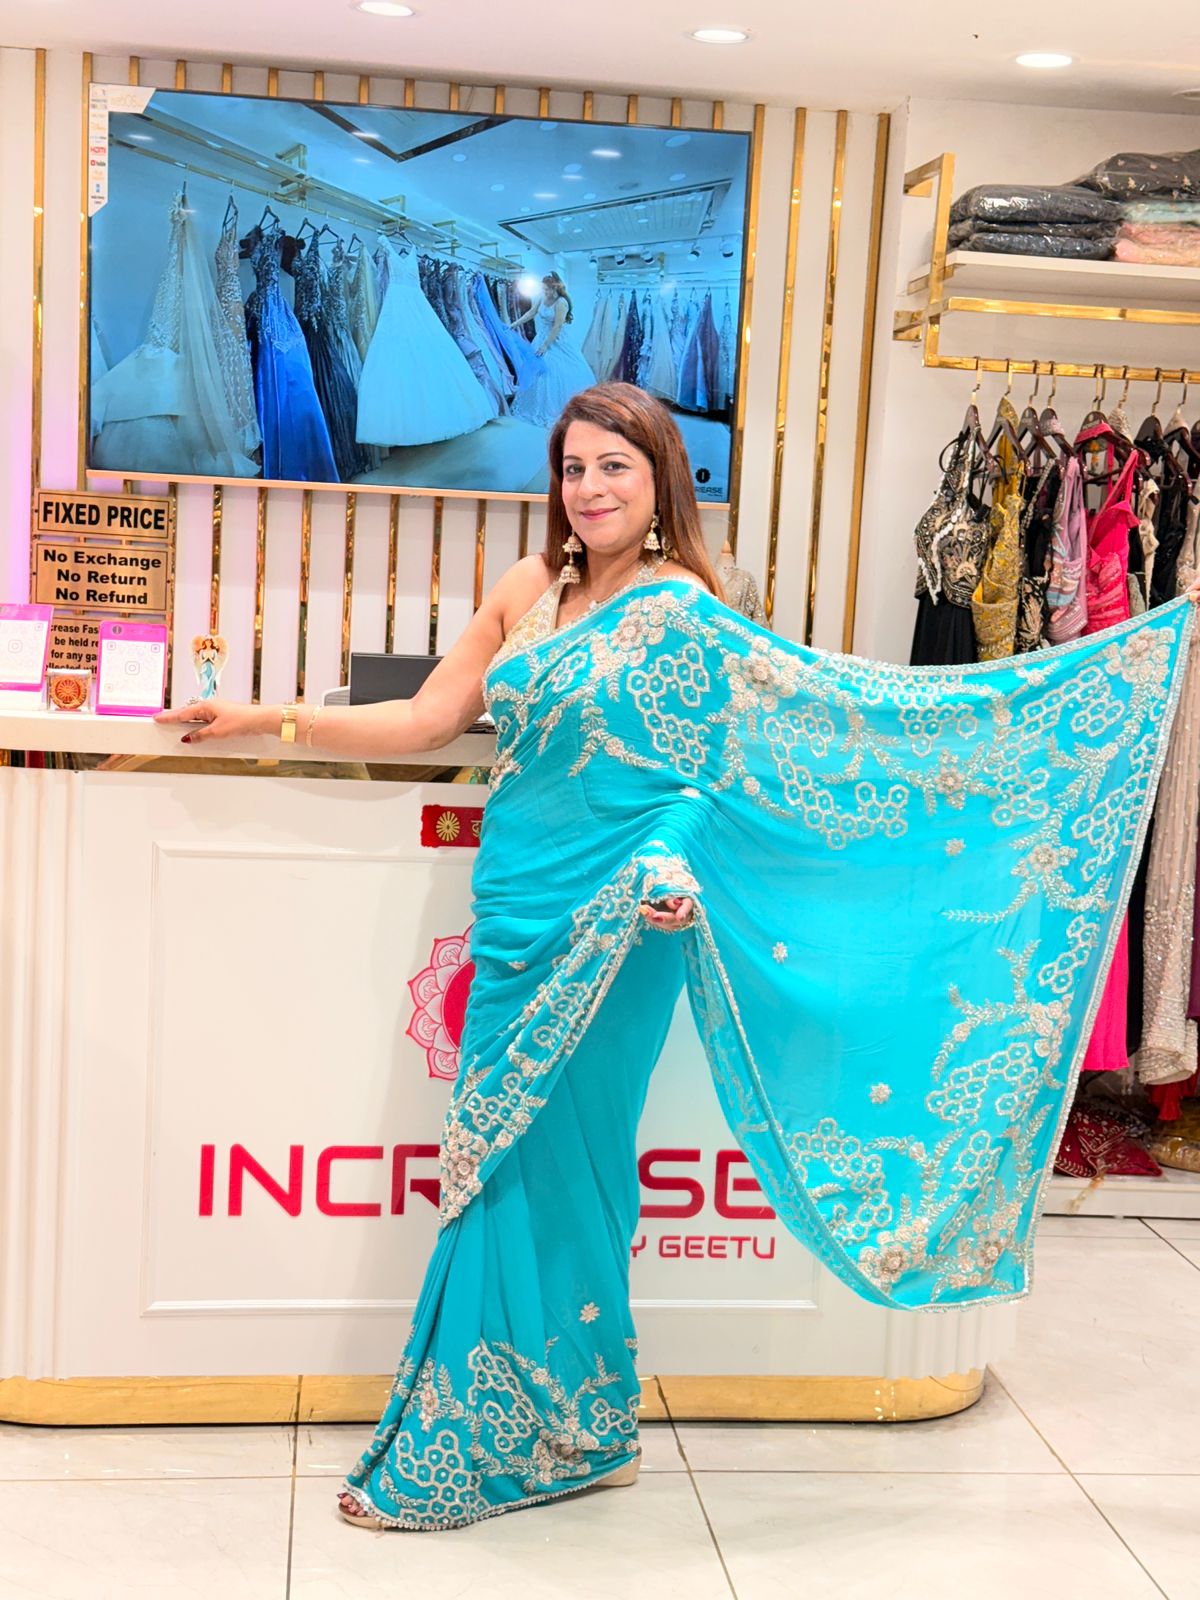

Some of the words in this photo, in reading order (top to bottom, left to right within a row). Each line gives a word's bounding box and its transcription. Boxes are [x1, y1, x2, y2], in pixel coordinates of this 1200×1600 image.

[695, 486, 724, 494] REASE
[43, 501, 100, 525] FIXED
[107, 505, 165, 530] PRICE
[43, 549, 68, 562] No
[74, 551, 161, 571] Exchange
[57, 569, 81, 582] No
[87, 570, 147, 586] Return
[56, 587, 79, 601] No
[86, 589, 148, 605] Refund
[51, 624, 80, 634] rease
[82, 624, 99, 634] Fas
[54, 636, 66, 646] be
[68, 636, 89, 647] held
[51, 649, 64, 659] for
[66, 652, 83, 663] any
[85, 653, 98, 663] ga
[630, 1235, 647, 1258] Y
[659, 1235, 775, 1259] GEETU
